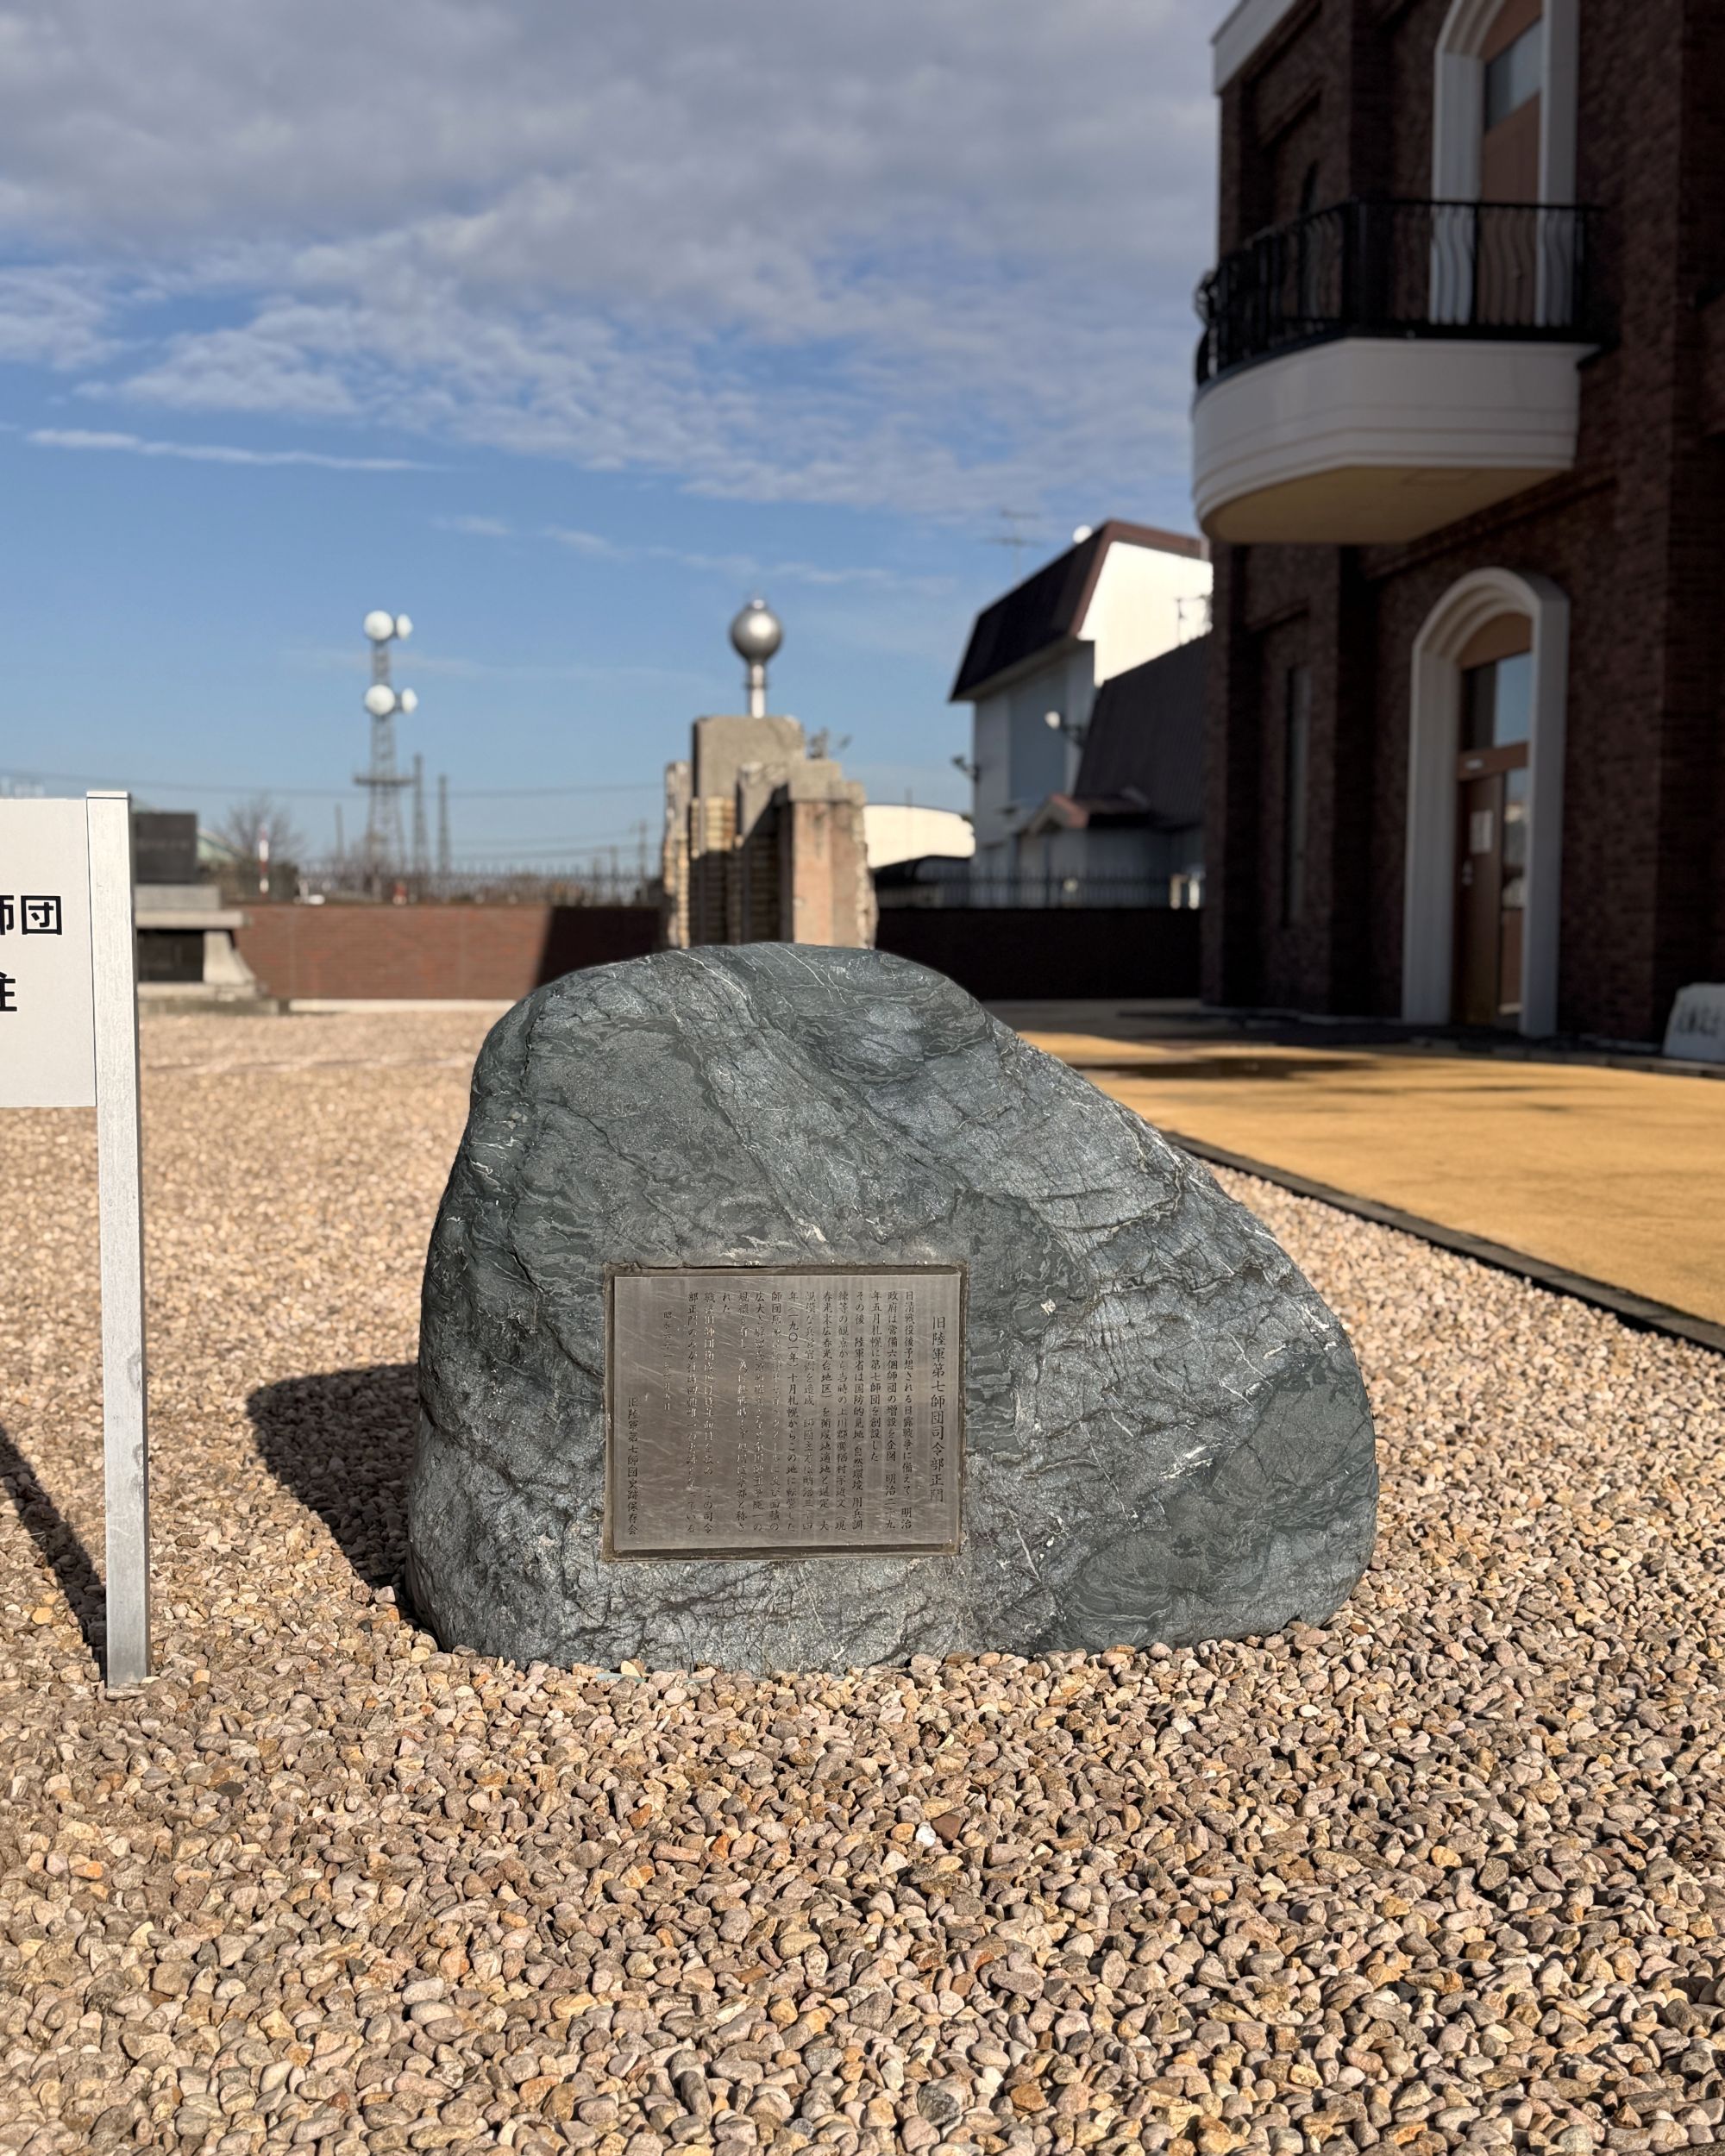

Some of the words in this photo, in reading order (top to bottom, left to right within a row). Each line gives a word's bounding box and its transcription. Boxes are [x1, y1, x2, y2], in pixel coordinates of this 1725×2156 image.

[723, 1293, 731, 1314] れた
[854, 1292, 864, 1325] その後
[703, 1489, 713, 1533] この司令
[900, 1507, 913, 1530] 明治
[819, 1520, 830, 1530] 大
